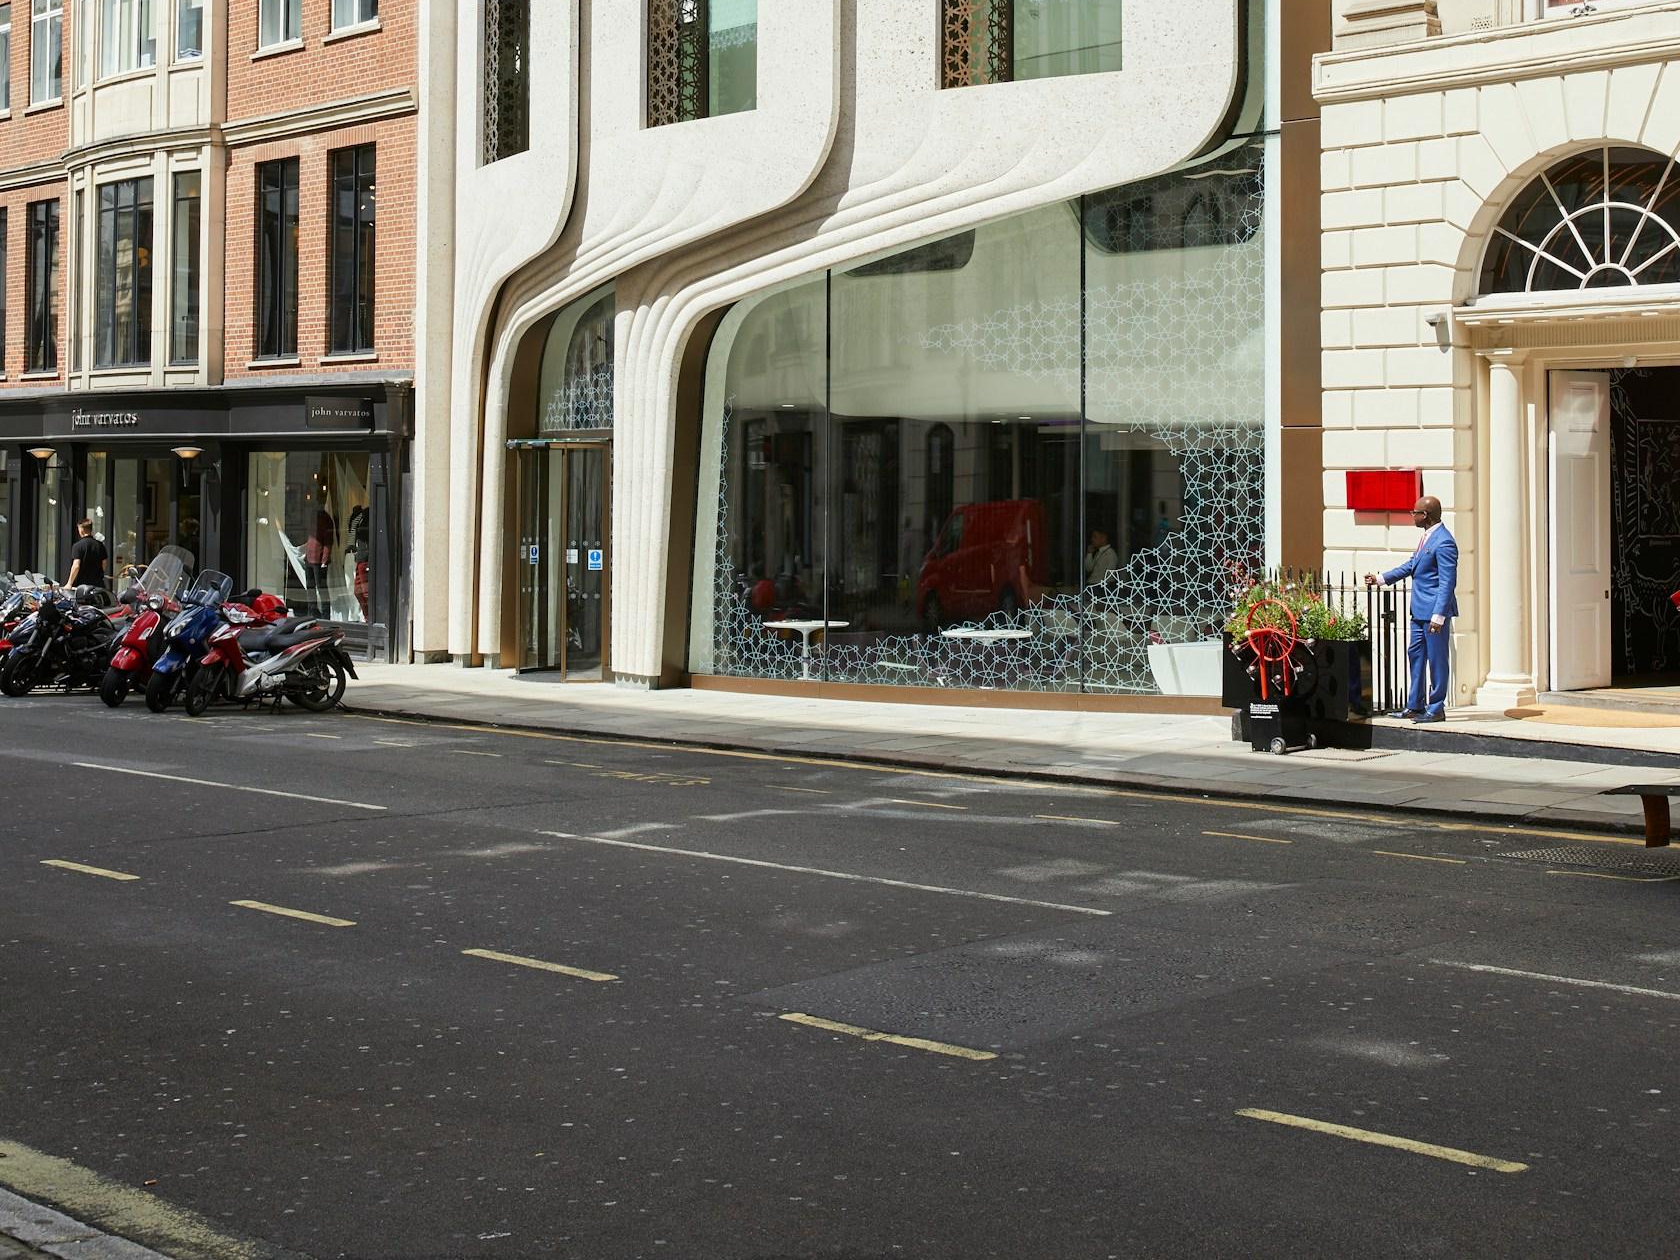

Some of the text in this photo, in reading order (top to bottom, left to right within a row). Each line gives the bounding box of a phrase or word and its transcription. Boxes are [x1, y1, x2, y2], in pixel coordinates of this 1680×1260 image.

[71, 408, 138, 431] john varvatos
[311, 406, 371, 418] john varvatos
